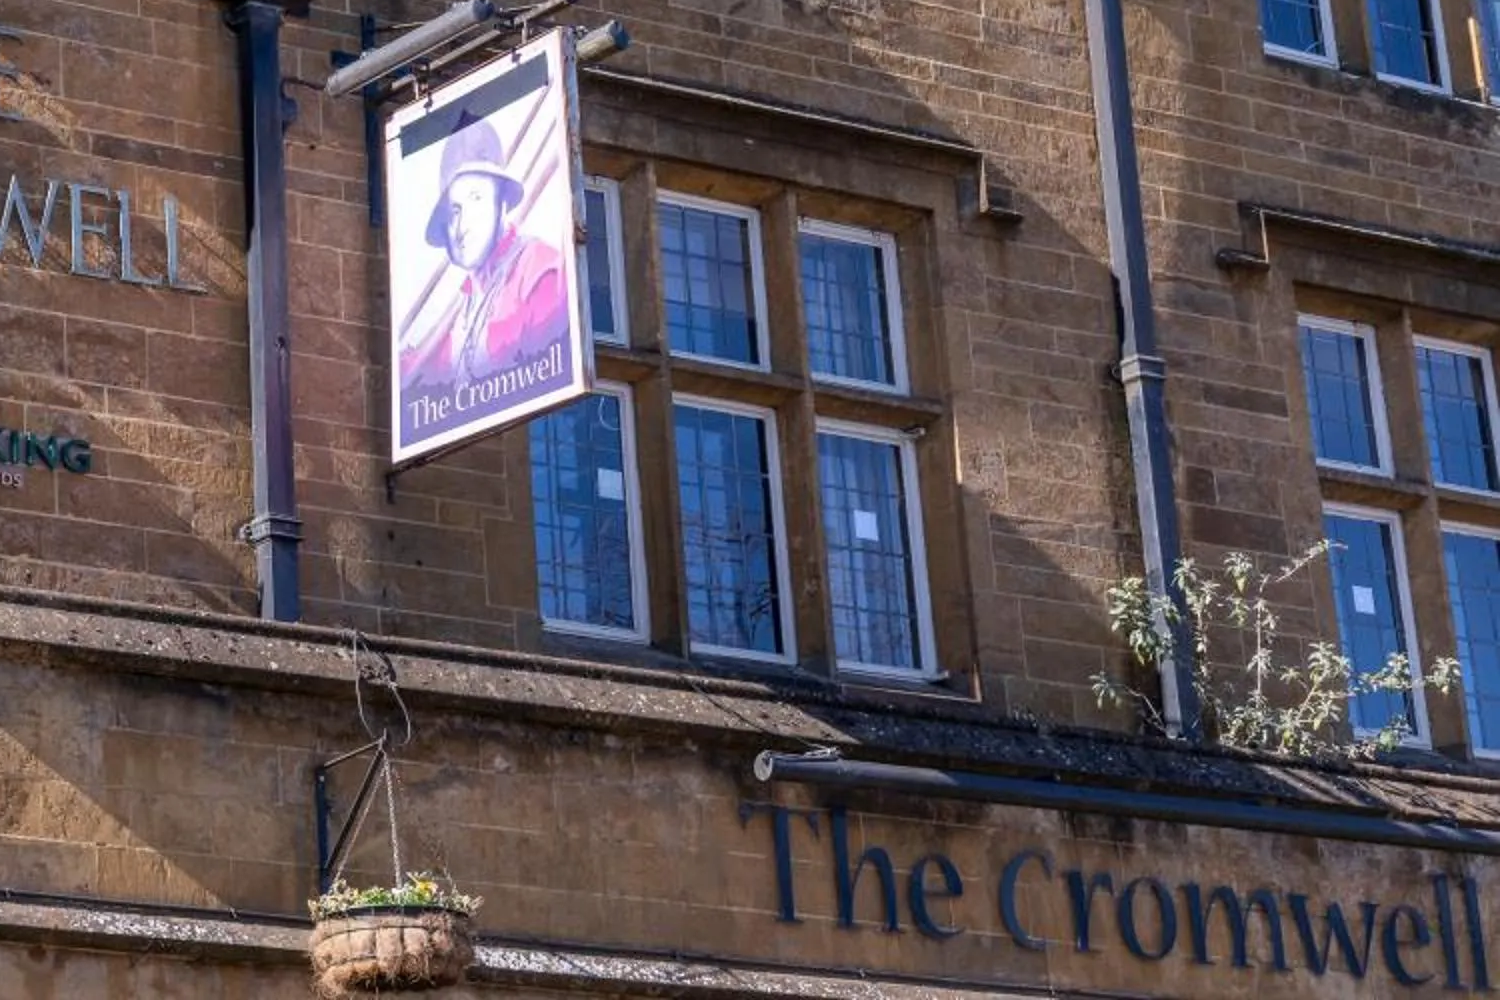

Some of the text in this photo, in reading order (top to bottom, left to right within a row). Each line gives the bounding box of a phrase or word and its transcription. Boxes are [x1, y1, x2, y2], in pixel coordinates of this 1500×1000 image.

[408, 343, 564, 430] The Cromwell
[738, 802, 1497, 992] The Cromwell
